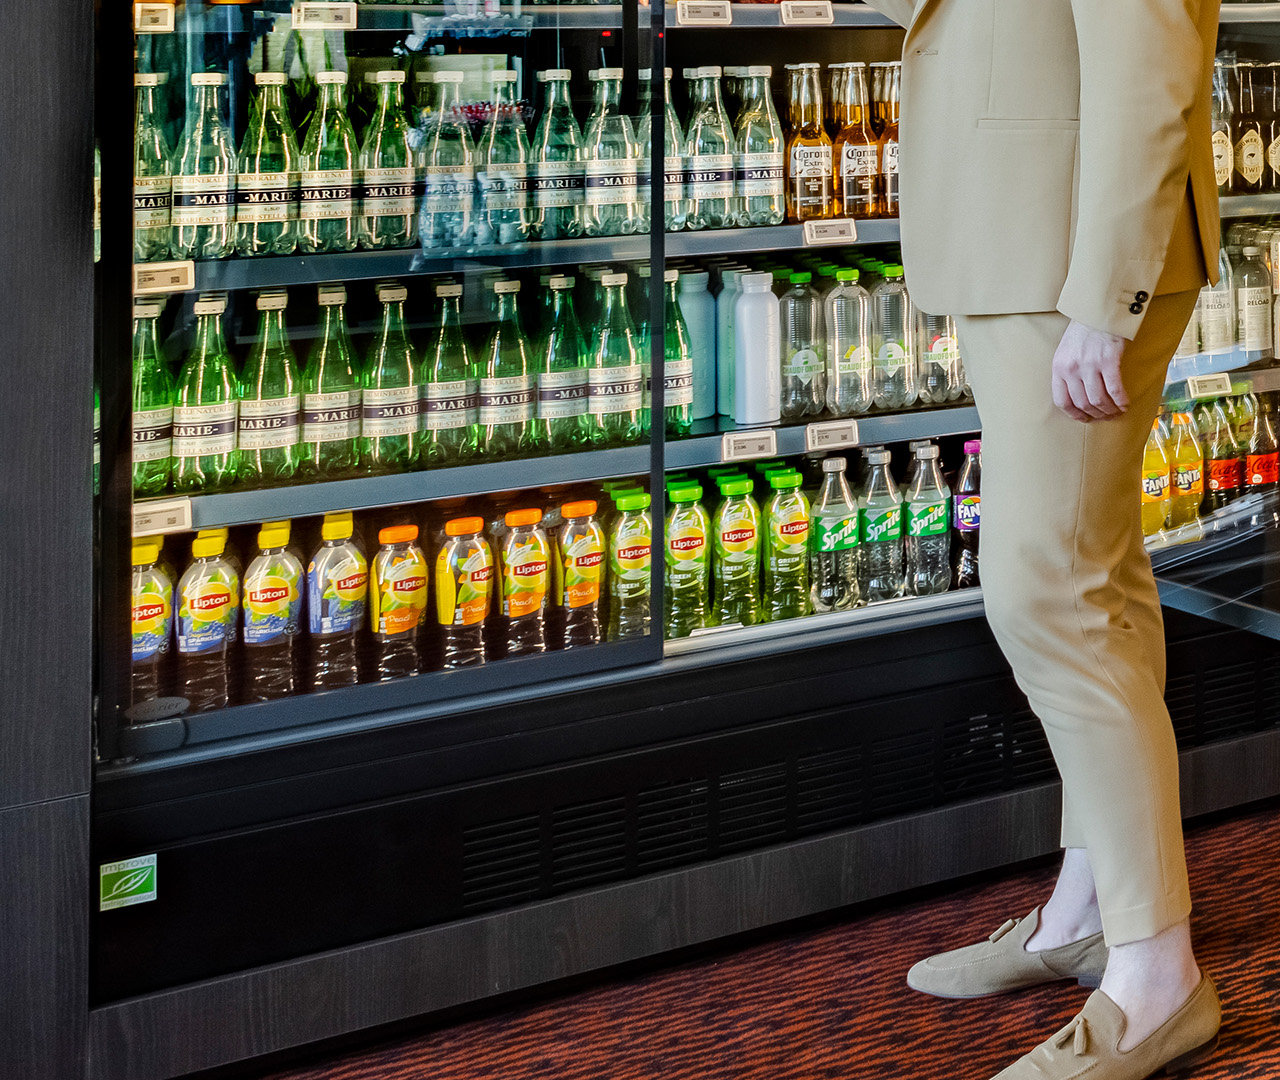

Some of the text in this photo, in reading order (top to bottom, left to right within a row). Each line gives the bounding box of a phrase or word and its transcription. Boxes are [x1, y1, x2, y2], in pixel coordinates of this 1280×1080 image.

[1247, 298, 1270, 306] RELOAD
[866, 505, 901, 542] Sprite
[910, 504, 946, 535] Sprite
[782, 520, 808, 534] Lipton
[822, 515, 859, 550] Sprite
[724, 528, 753, 542] Lipton
[673, 536, 702, 550] Lipton
[619, 545, 650, 558] Lipton
[777, 556, 800, 565] GREEN
[516, 562, 547, 575] Lipton
[341, 576, 366, 588] Lipton
[396, 579, 425, 590] Lipton
[252, 588, 286, 601] Lipton
[571, 587, 595, 597] Peach
[193, 594, 229, 608] Lipton
[511, 597, 535, 607] Peach
[101, 856, 155, 874] improve
